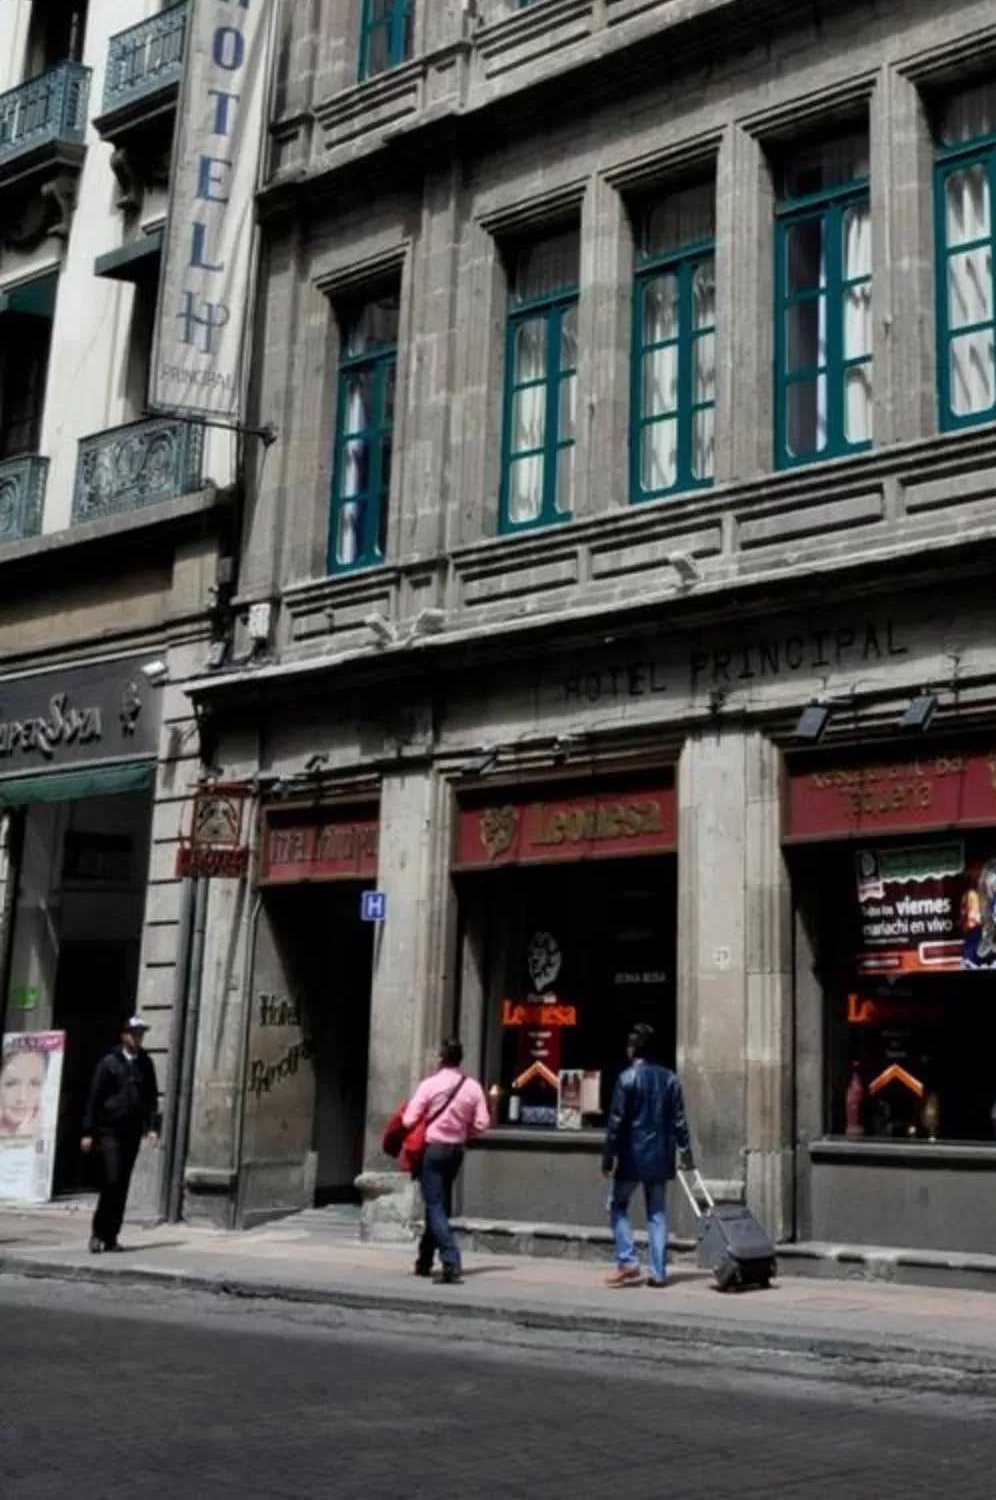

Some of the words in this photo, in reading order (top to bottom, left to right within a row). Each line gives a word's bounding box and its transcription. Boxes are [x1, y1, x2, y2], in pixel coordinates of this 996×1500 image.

[689, 618, 909, 694] PRINCIPAL
[564, 658, 667, 702] HOTEL
[367, 894, 383, 917] H
[895, 894, 953, 916] viernes
[910, 917, 926, 934] en
[927, 915, 954, 933] vivo
[501, 998, 579, 1028] Leesa
